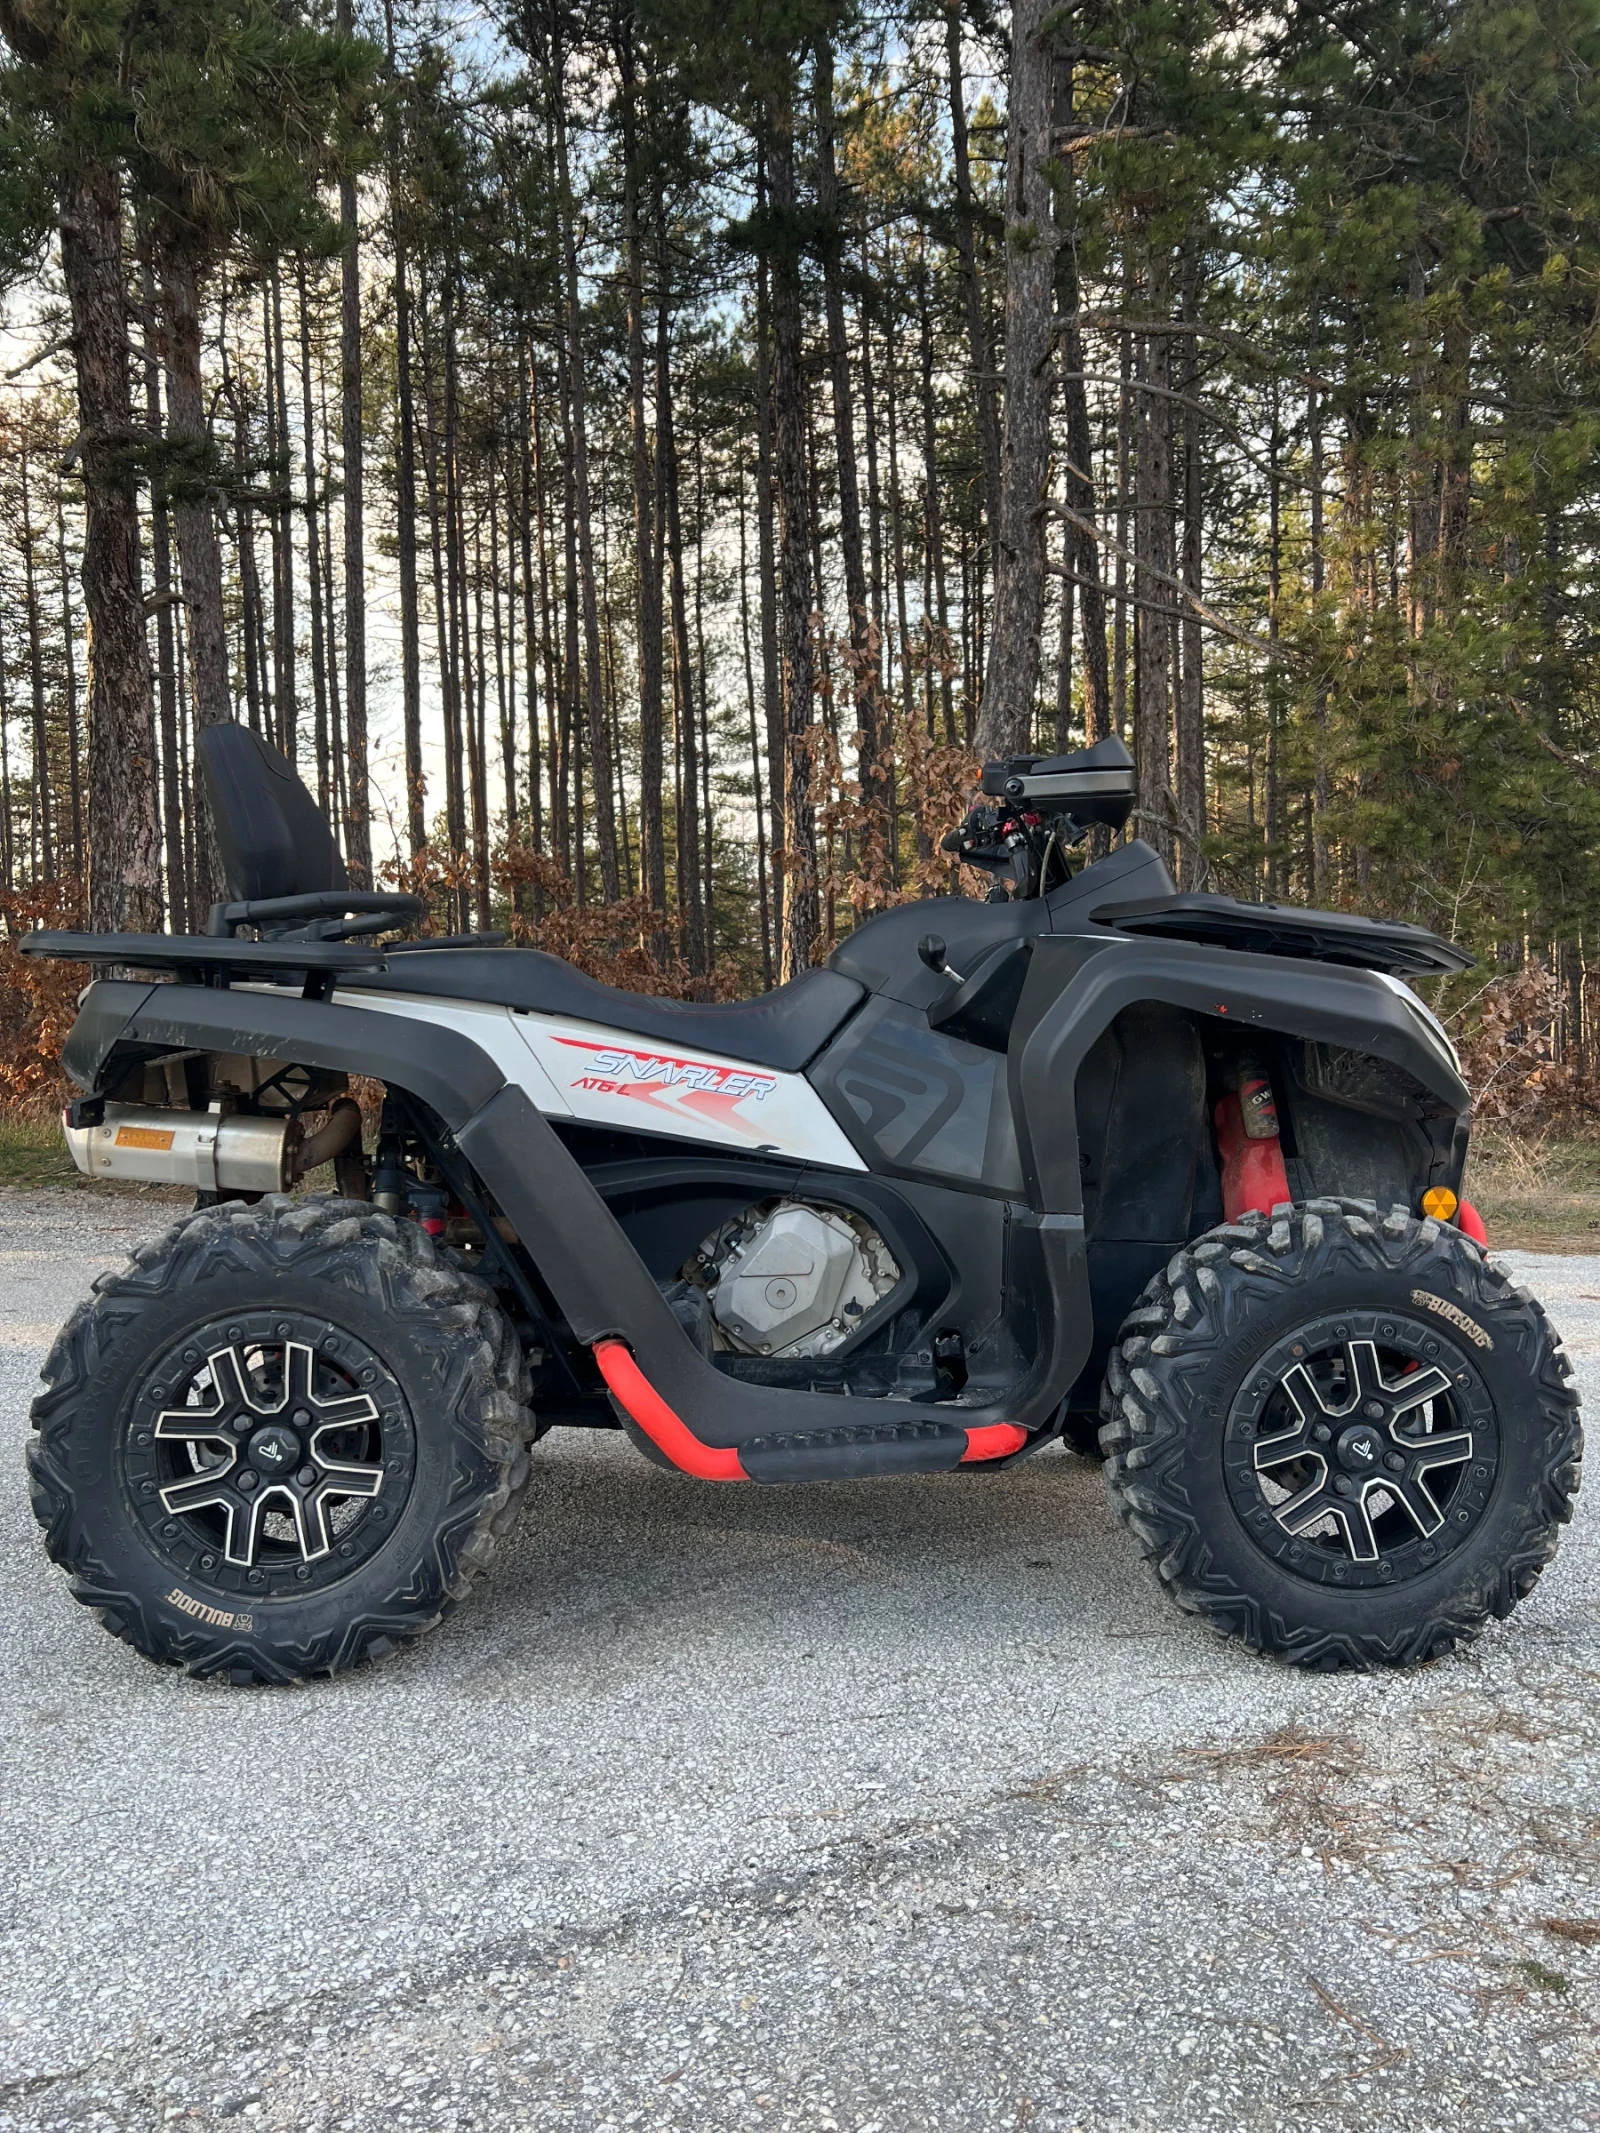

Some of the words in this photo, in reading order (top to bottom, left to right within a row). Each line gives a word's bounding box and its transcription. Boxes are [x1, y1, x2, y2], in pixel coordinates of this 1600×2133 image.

[584, 1051, 777, 1100] SNARLER
[1427, 1293, 1490, 1349] BULLDOG
[392, 1470, 442, 1566] BULLDOG
[167, 1588, 234, 1627] BULLDOG
